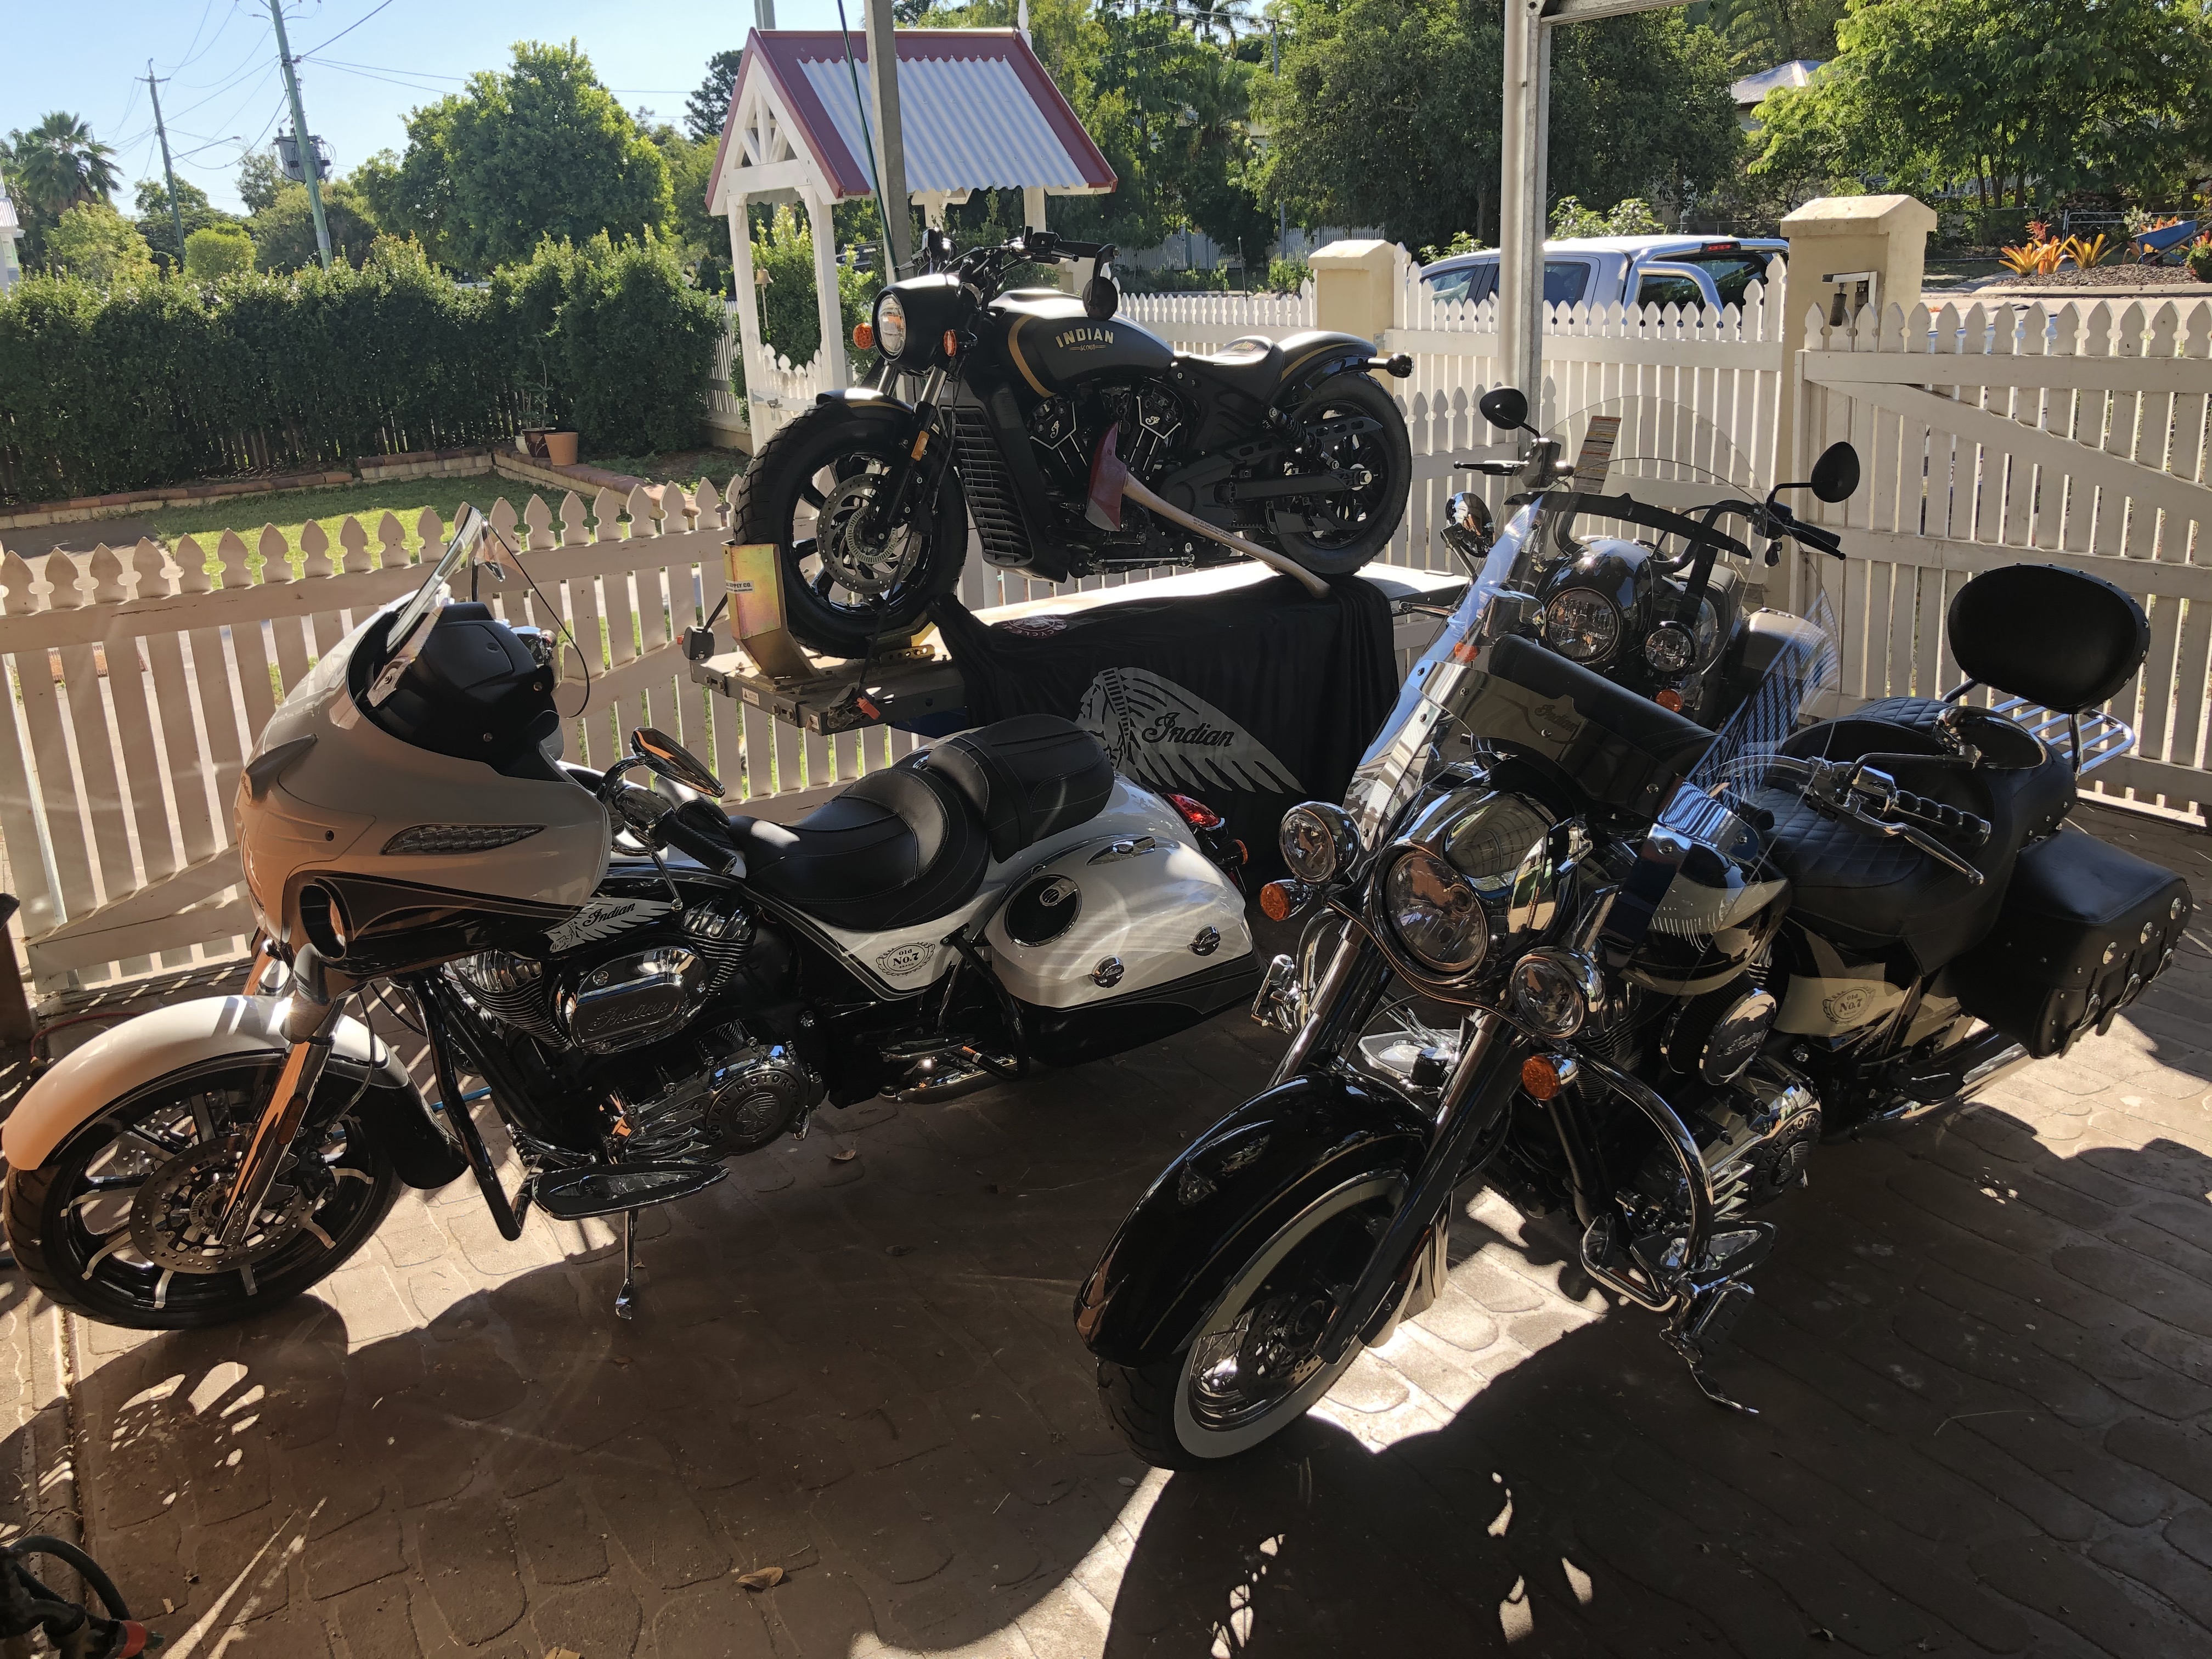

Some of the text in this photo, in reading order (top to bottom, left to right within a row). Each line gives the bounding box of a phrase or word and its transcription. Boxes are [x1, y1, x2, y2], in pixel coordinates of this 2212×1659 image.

[1055, 328, 1114, 348] INDIAN
[1142, 712, 1234, 747] Indian
[583, 903, 635, 927] Indian
[588, 1002, 669, 1031] Indian
